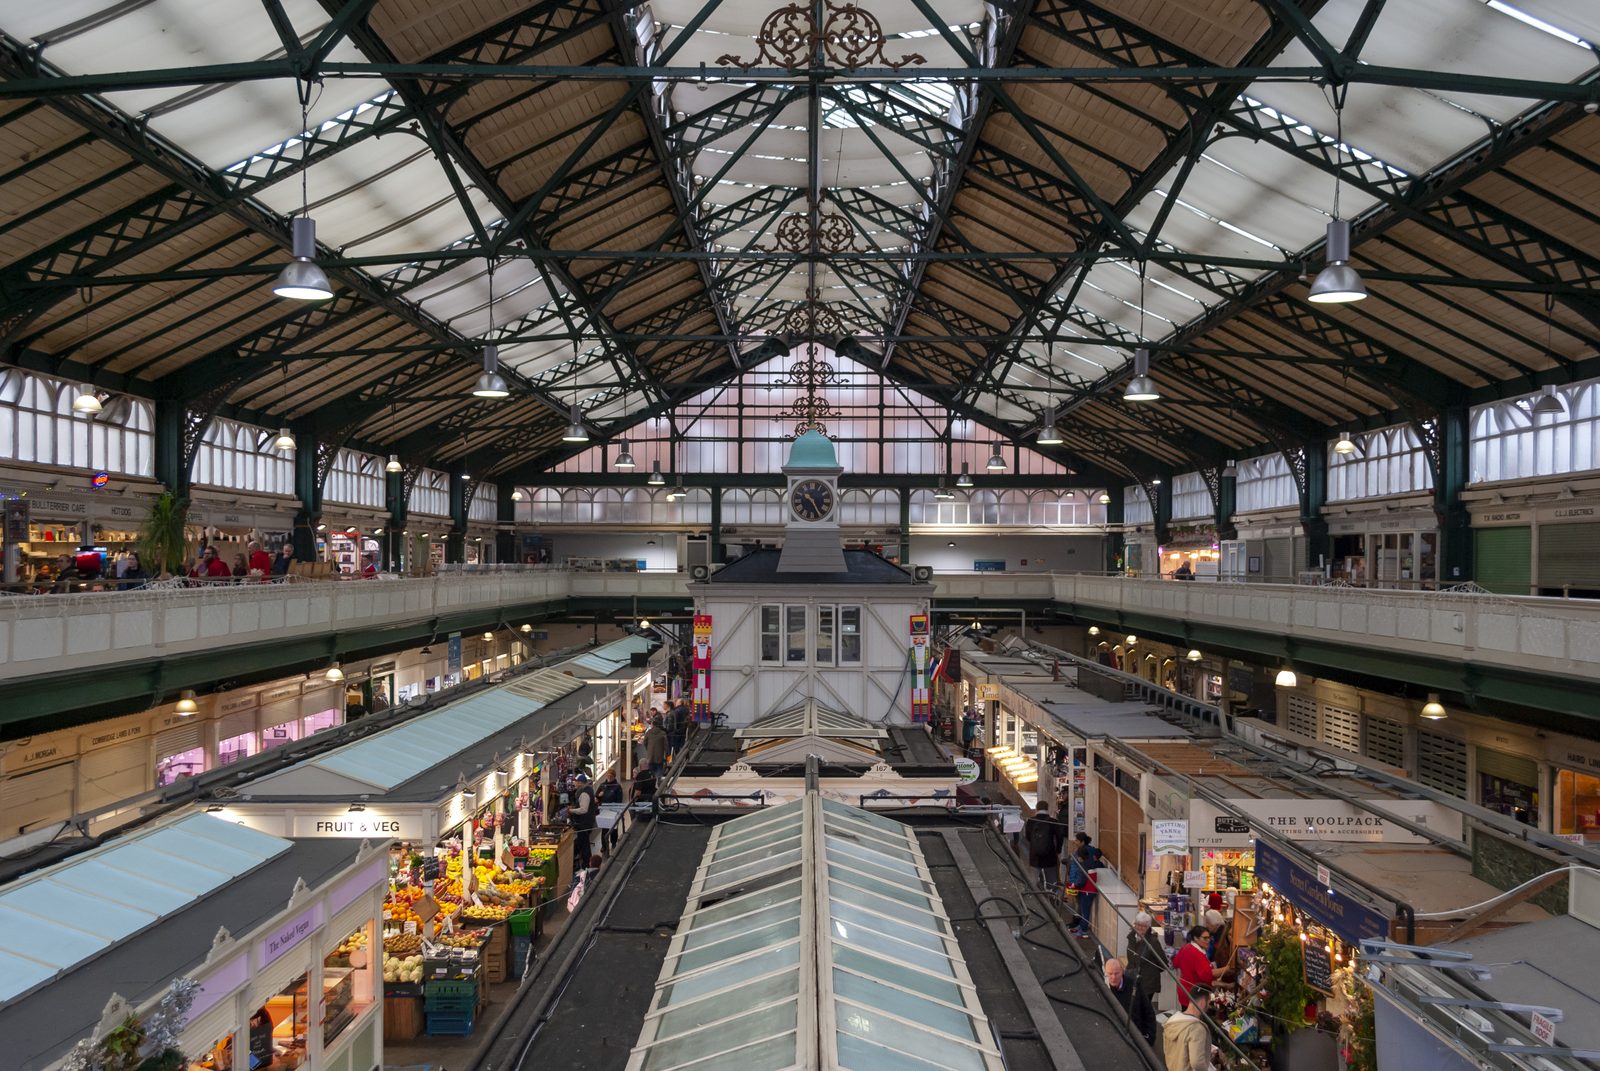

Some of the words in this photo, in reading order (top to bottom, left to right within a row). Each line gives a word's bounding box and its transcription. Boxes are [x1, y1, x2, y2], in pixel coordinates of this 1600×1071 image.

[31, 500, 70, 512] BULLTERRIER
[71, 503, 86, 513] CAFE
[34, 748, 57, 759] MORGAN
[1567, 752, 1585, 765] HARD
[316, 821, 354, 832] FRUIT
[359, 822, 368, 832] &
[373, 821, 400, 832] VEG
[1267, 816, 1297, 826] THE
[1303, 816, 1384, 827] WOOLPACK
[269, 941, 280, 954] The
[280, 927, 296, 944] Naked
[295, 920, 310, 935] Vegan
[1533, 1014, 1553, 1033] FRAGILE
[1535, 1026, 1550, 1041] ROOF
